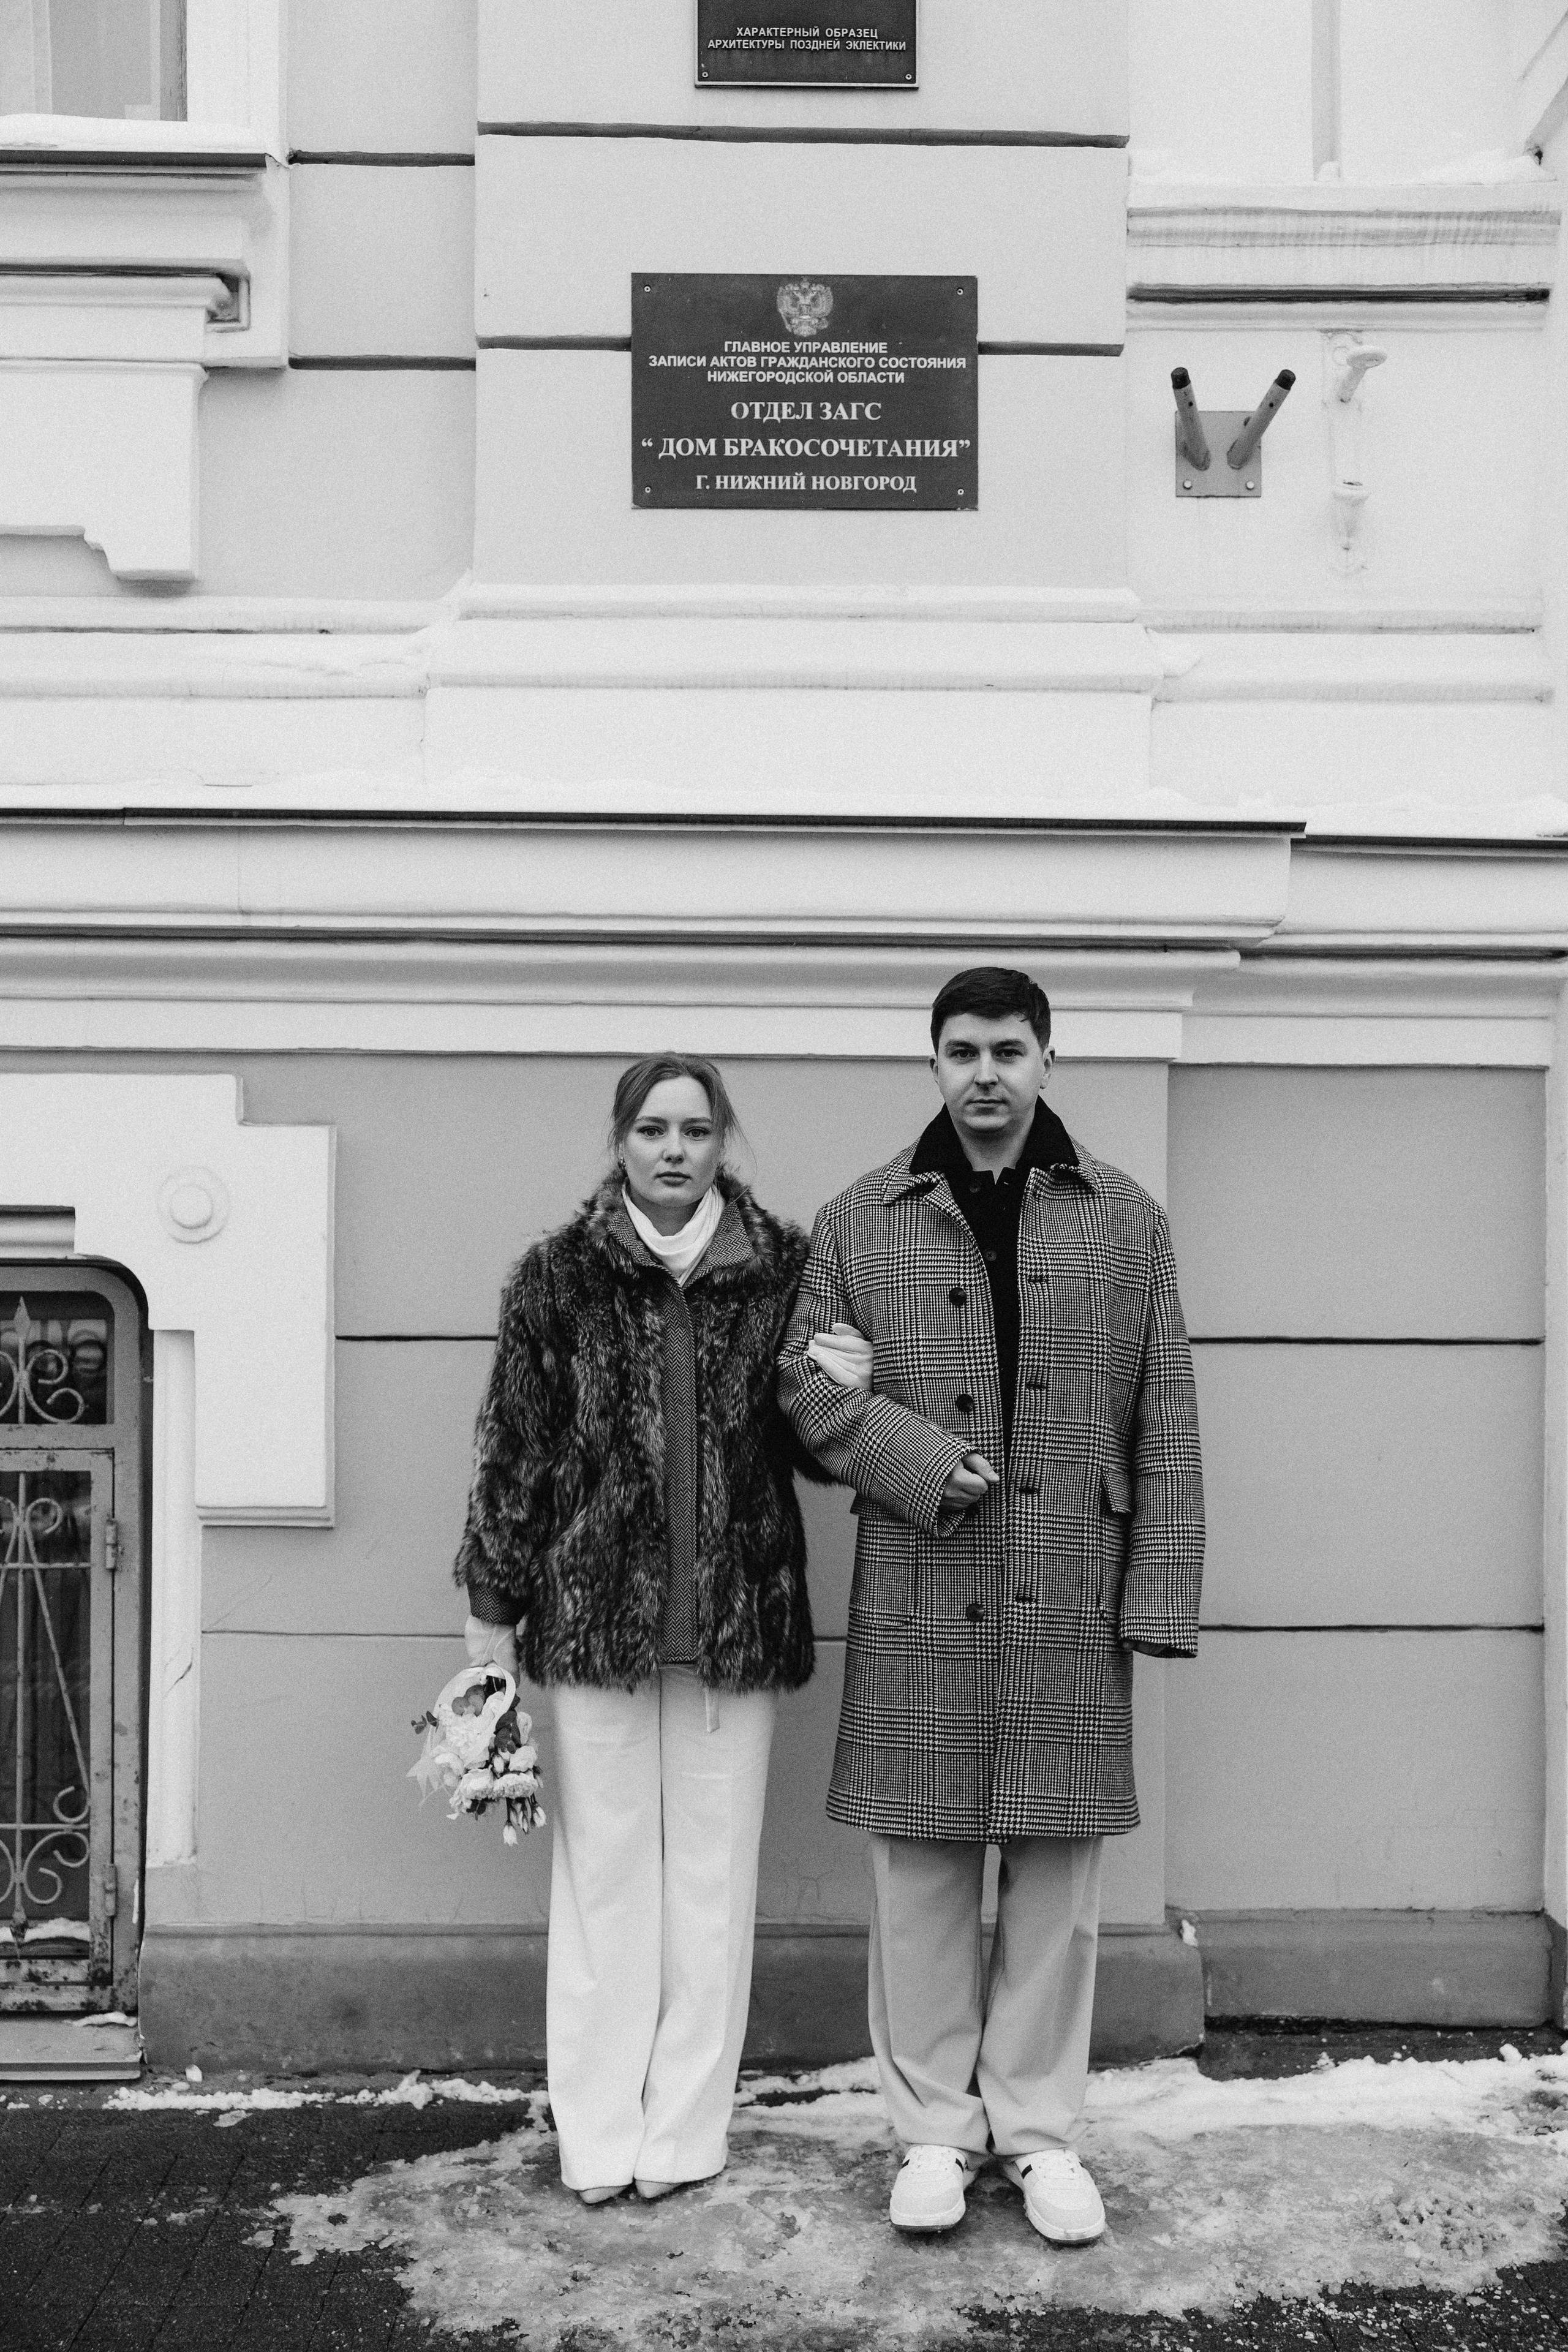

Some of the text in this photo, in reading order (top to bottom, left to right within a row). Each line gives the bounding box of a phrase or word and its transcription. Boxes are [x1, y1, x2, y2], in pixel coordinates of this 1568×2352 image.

[736, 26, 878, 39] ХАРАКТЕРНЫЙ ОБРАЗЕЦ
[707, 39, 906, 51] АРХИТЕКТУРЫ ПОЗДНЕЙ ЭКЛЕКТИКИ
[724, 341, 888, 353] ГЛАВНОЕ УПРАВЛЕНИЕ
[649, 356, 967, 369] ЗАПИСИ АКТОВ ГРАЖДАНСКОГО СОСТОЯНИЯ
[707, 369, 905, 385] НИЖЕГОРОДСКОЙ ОБЛАСТИ
[731, 402, 882, 423] ОТДЕЛ ЗАГС
[723, 438, 971, 458] БРАКОСОЧЕТАНИЯ”
[696, 472, 917, 493] Г. НИЖНИЙ НОВГОРОД
